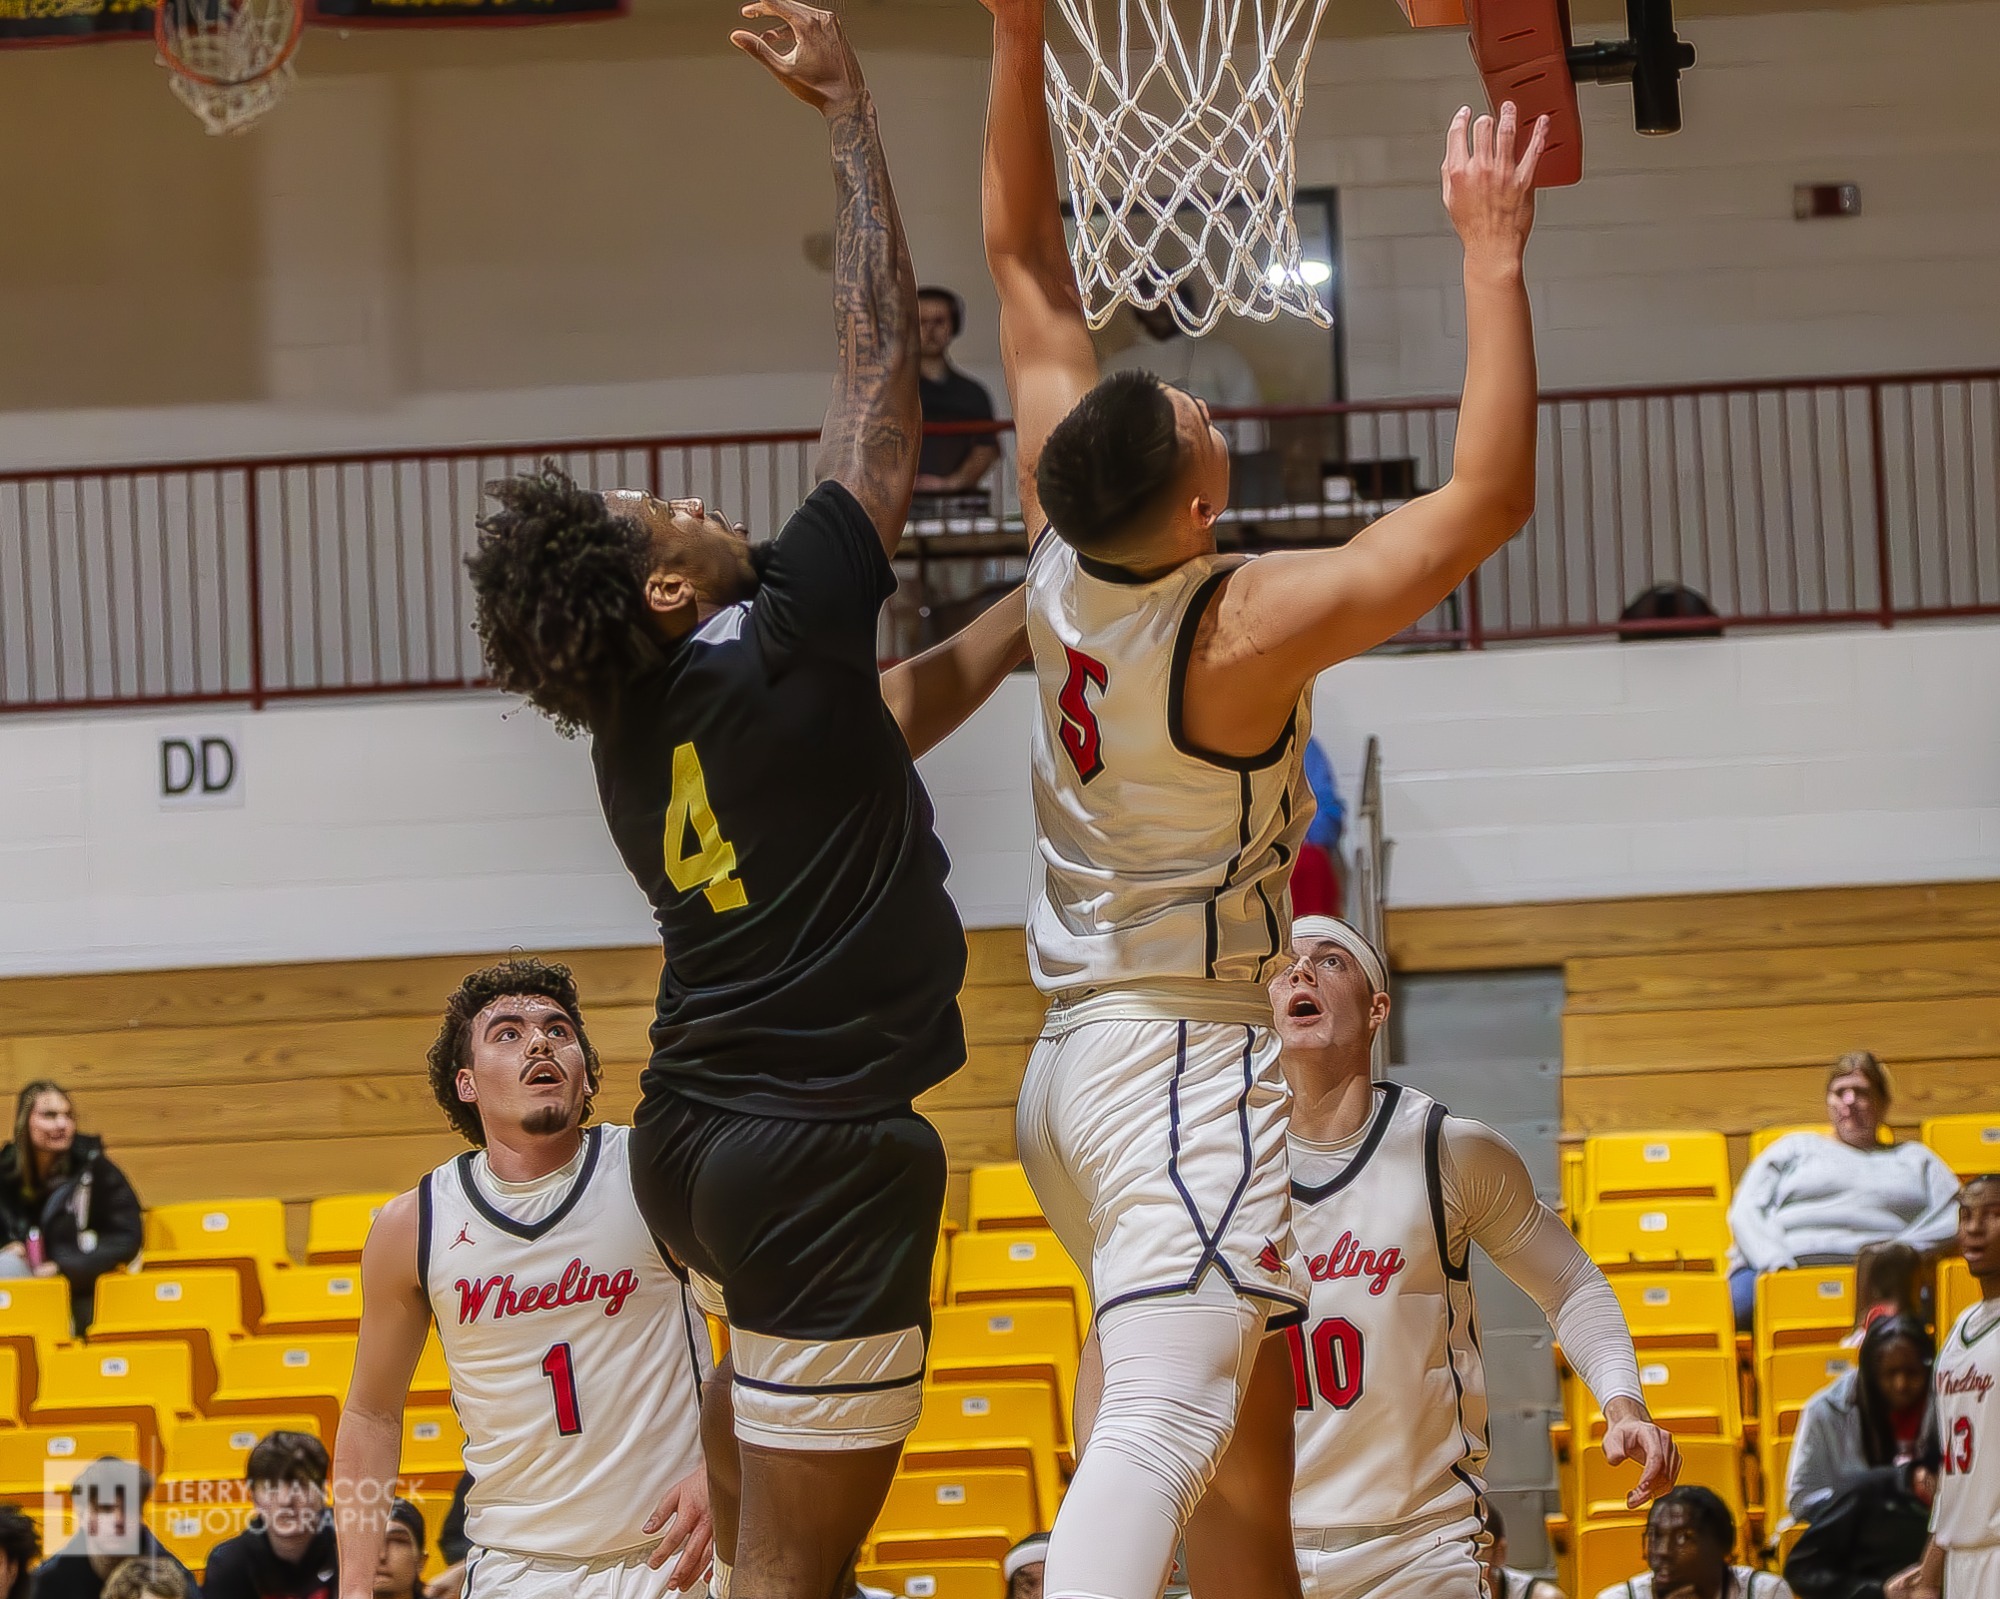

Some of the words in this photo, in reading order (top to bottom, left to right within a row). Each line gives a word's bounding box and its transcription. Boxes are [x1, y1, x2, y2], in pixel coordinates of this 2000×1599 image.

[1057, 644, 1107, 787] 5
[162, 738, 234, 793] DD
[663, 741, 749, 913] 4
[454, 1257, 639, 1325] Wheeling
[1303, 1230, 1405, 1296] eling
[541, 1342, 583, 1437] 1
[1284, 1316, 1365, 1411] 10
[1943, 1416, 1974, 1475] 13
